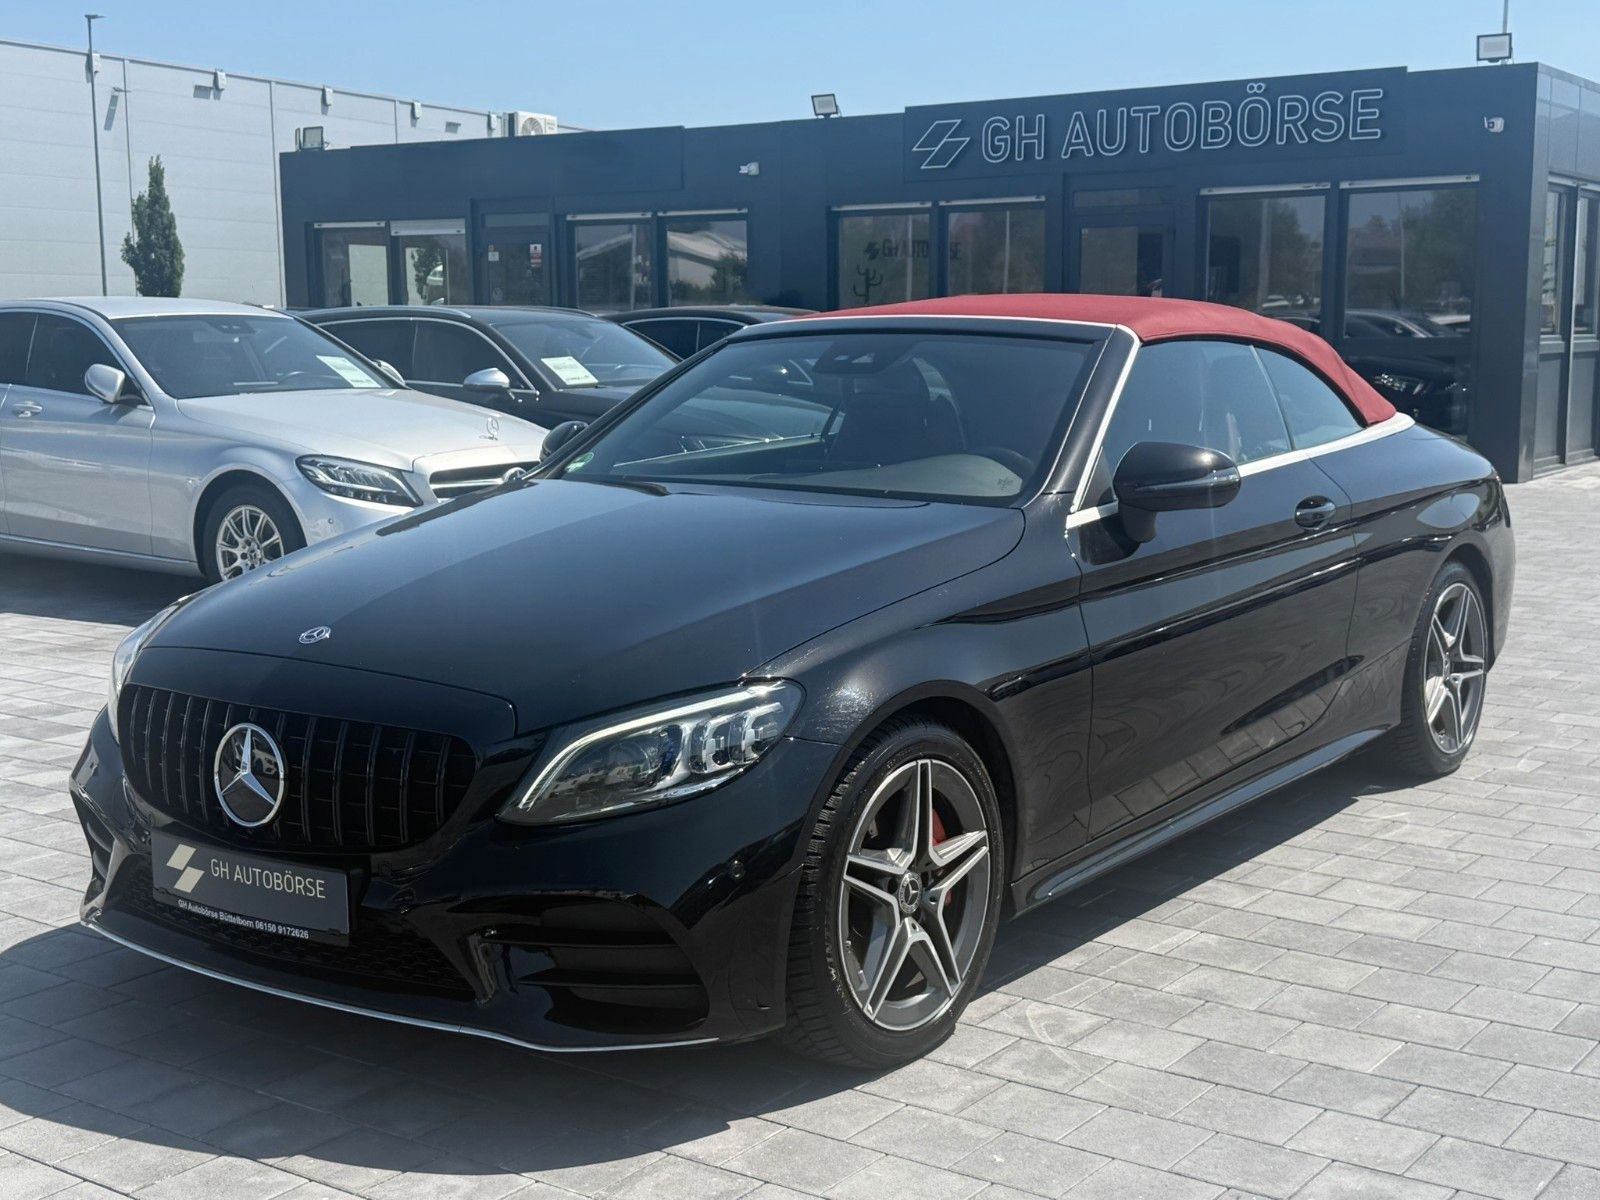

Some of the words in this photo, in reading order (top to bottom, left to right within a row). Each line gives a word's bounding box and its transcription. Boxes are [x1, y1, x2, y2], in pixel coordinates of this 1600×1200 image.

[981, 115, 1046, 163] GH
[1061, 82, 1384, 161] AUTOBÖRSE
[210, 858, 230, 880] GH
[234, 865, 326, 898] AUTOBÖRSE
[187, 902, 218, 919] Autobörse
[255, 920, 277, 933] 06150
[277, 925, 310, 940] 9172626
